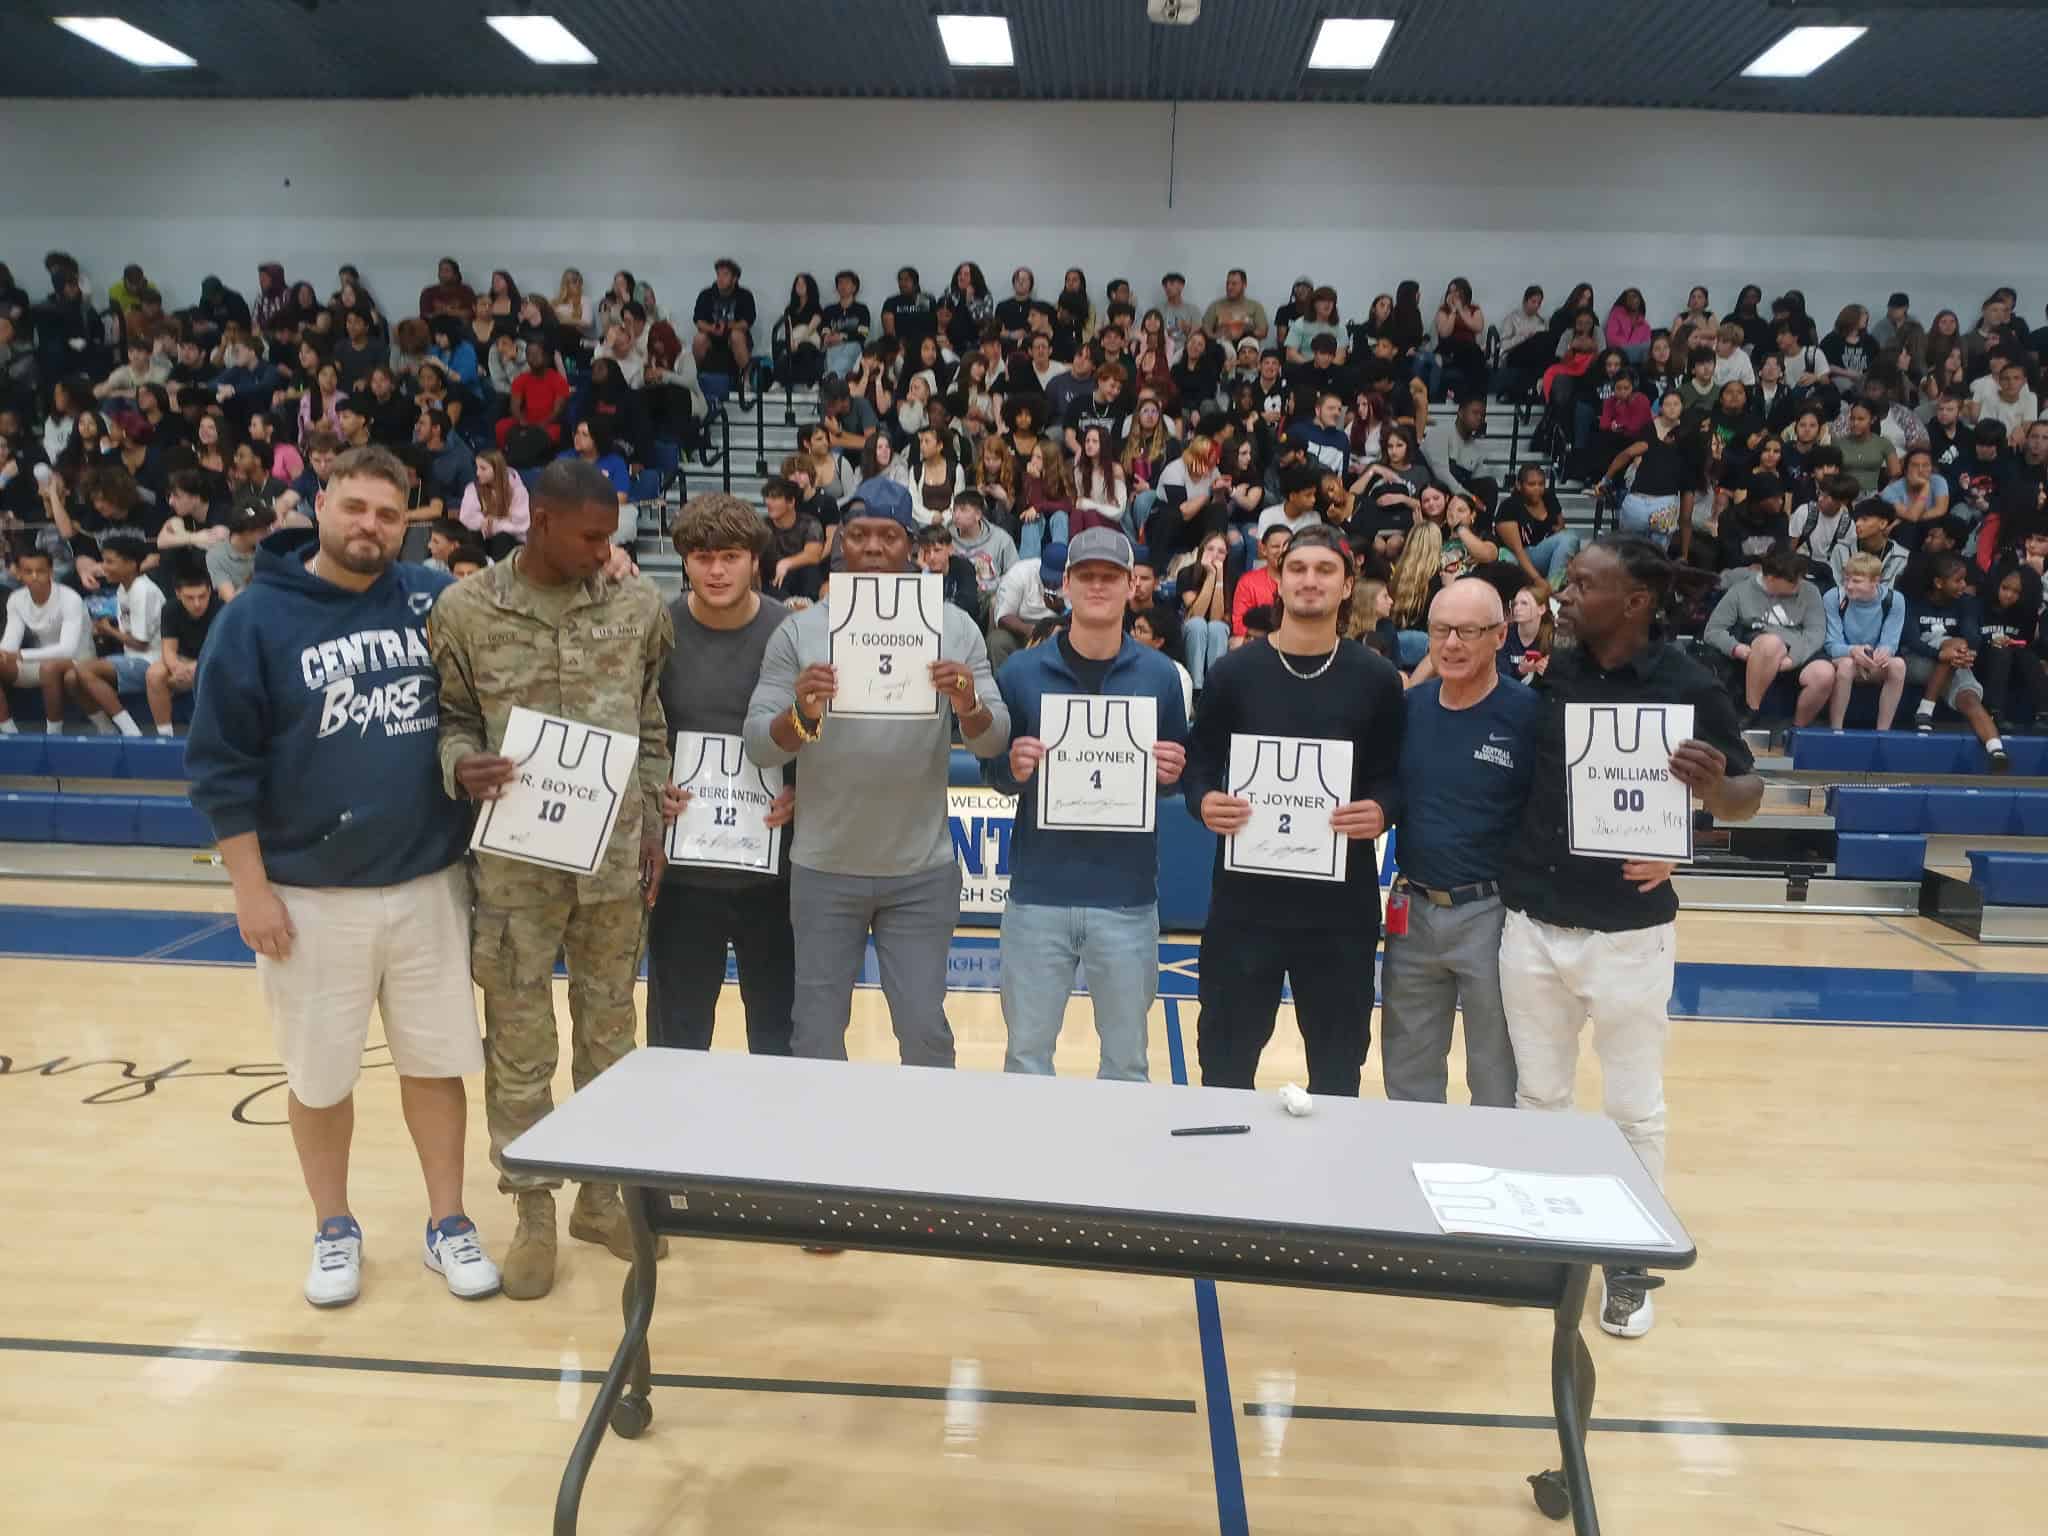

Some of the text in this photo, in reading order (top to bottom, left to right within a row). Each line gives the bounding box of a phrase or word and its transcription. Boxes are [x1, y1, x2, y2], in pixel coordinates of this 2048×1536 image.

[848, 632, 924, 648] T. GOODSON
[301, 627, 433, 690] CENTRA
[878, 653, 893, 675] 3
[1057, 750, 1136, 764] B. JOYNER
[1089, 769, 1102, 790] 4
[1588, 766, 1669, 783] D. WILLIAMS
[520, 772, 600, 802] R. BOYCE
[699, 786, 768, 806] BERGANTINO
[1247, 791, 1326, 810] T. JOYNER
[1613, 788, 1645, 812] 00
[537, 799, 567, 823] 10
[713, 805, 737, 827] 12
[1277, 813, 1292, 834] 2
